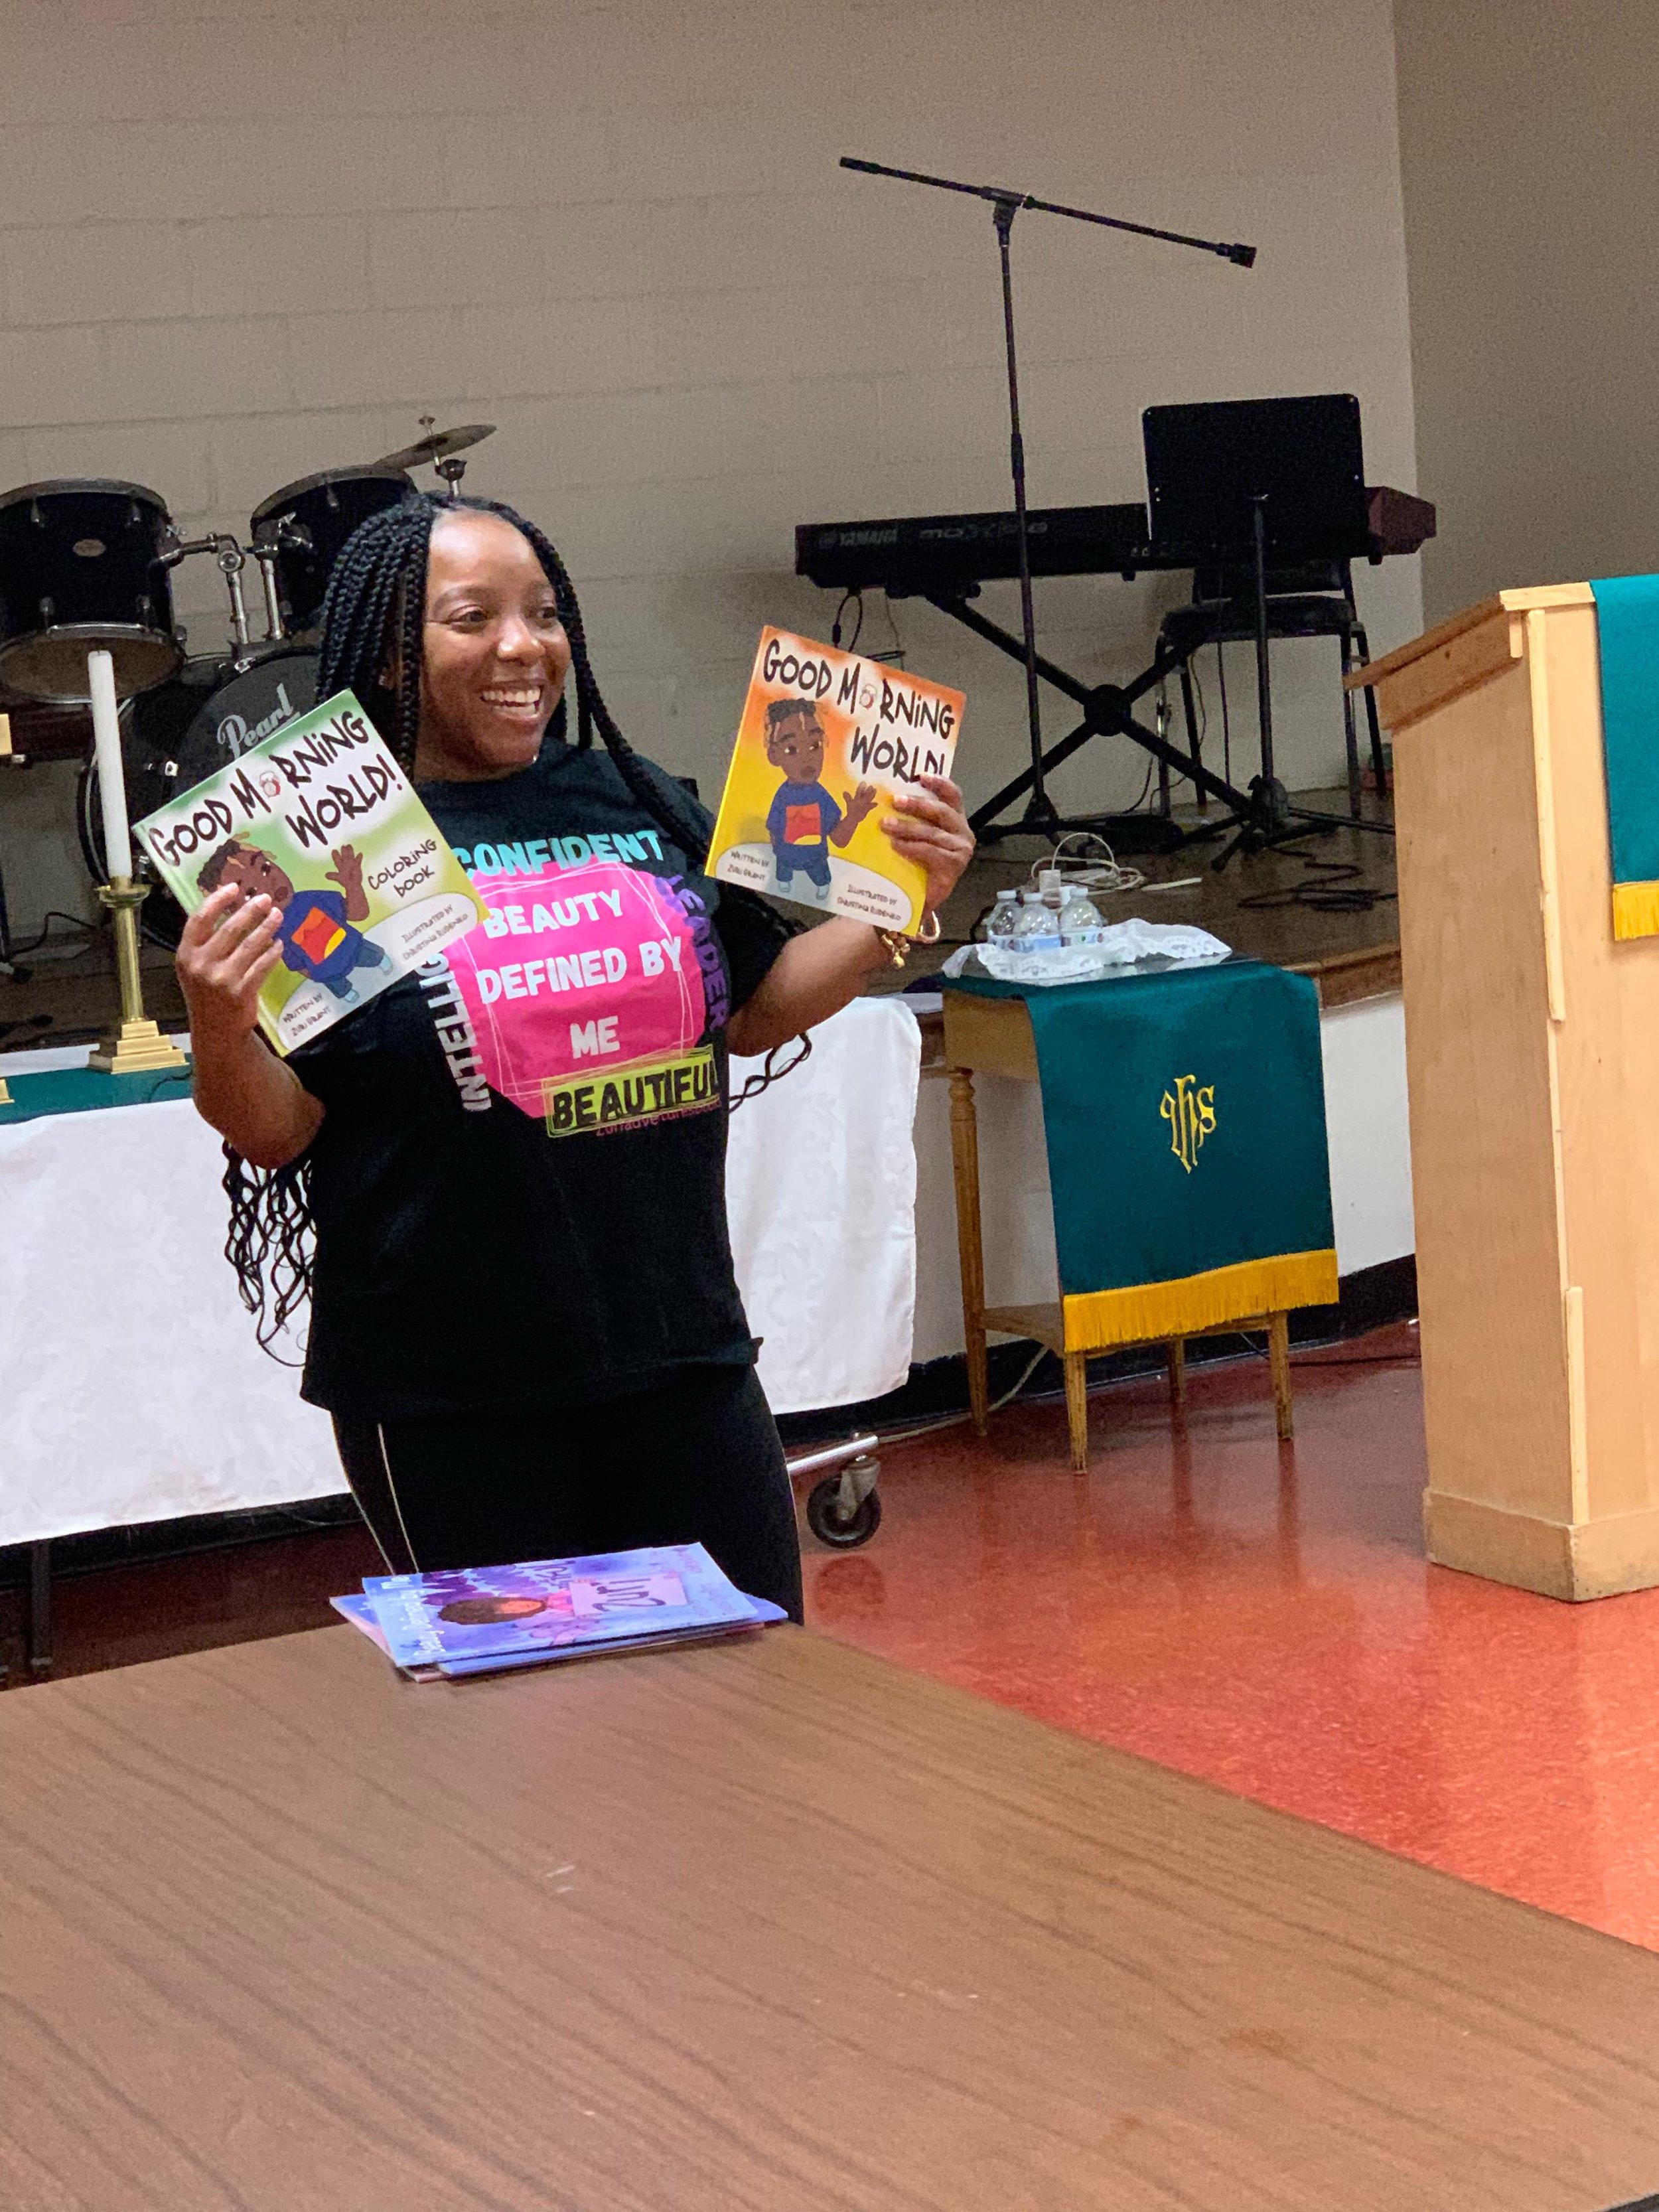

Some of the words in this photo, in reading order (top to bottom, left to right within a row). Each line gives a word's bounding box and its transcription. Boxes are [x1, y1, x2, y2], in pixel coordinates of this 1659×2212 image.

[762, 638, 832, 697] GOOD
[217, 682, 294, 760] Pearl
[148, 798, 232, 867] GOOD
[285, 753, 403, 848] WORLD!
[451, 829, 664, 879] CONFIDENT
[483, 889, 624, 939] BEAUTY
[476, 947, 628, 1005] DEFINED
[639, 936, 682, 978] BY
[569, 1016, 620, 1059] ME
